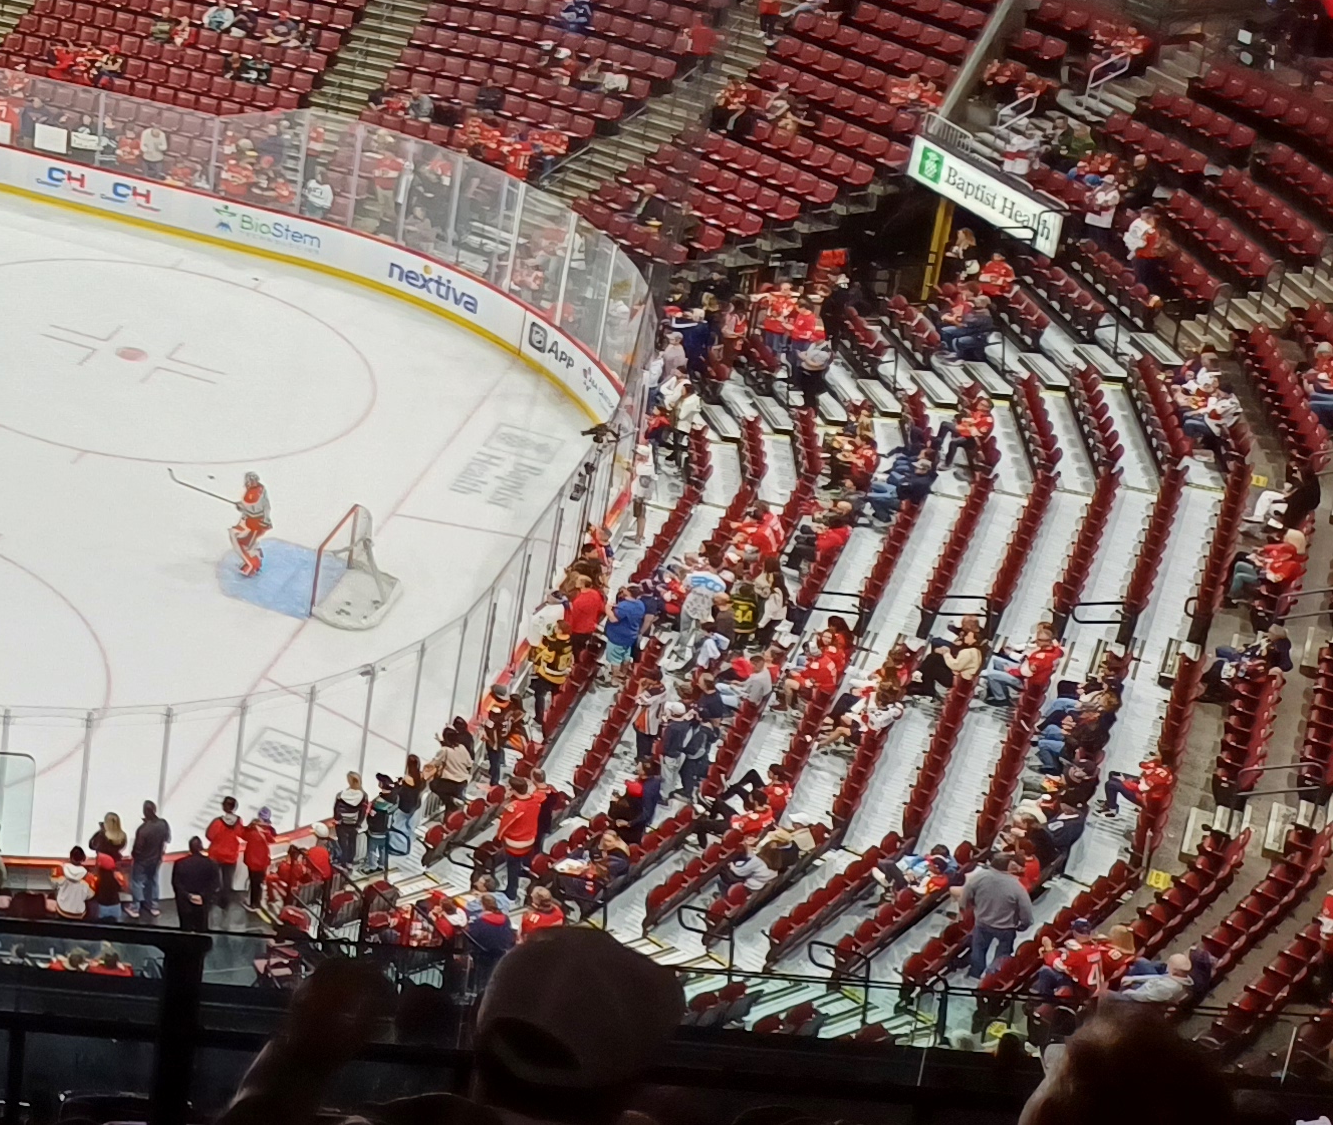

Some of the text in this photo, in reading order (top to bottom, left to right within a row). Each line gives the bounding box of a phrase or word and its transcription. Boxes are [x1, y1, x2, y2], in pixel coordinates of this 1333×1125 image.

[944, 166, 1051, 240] Baptist Healh
[239, 215, 321, 249] BioStem
[388, 262, 478, 315] nextiva
[548, 340, 575, 369] App
